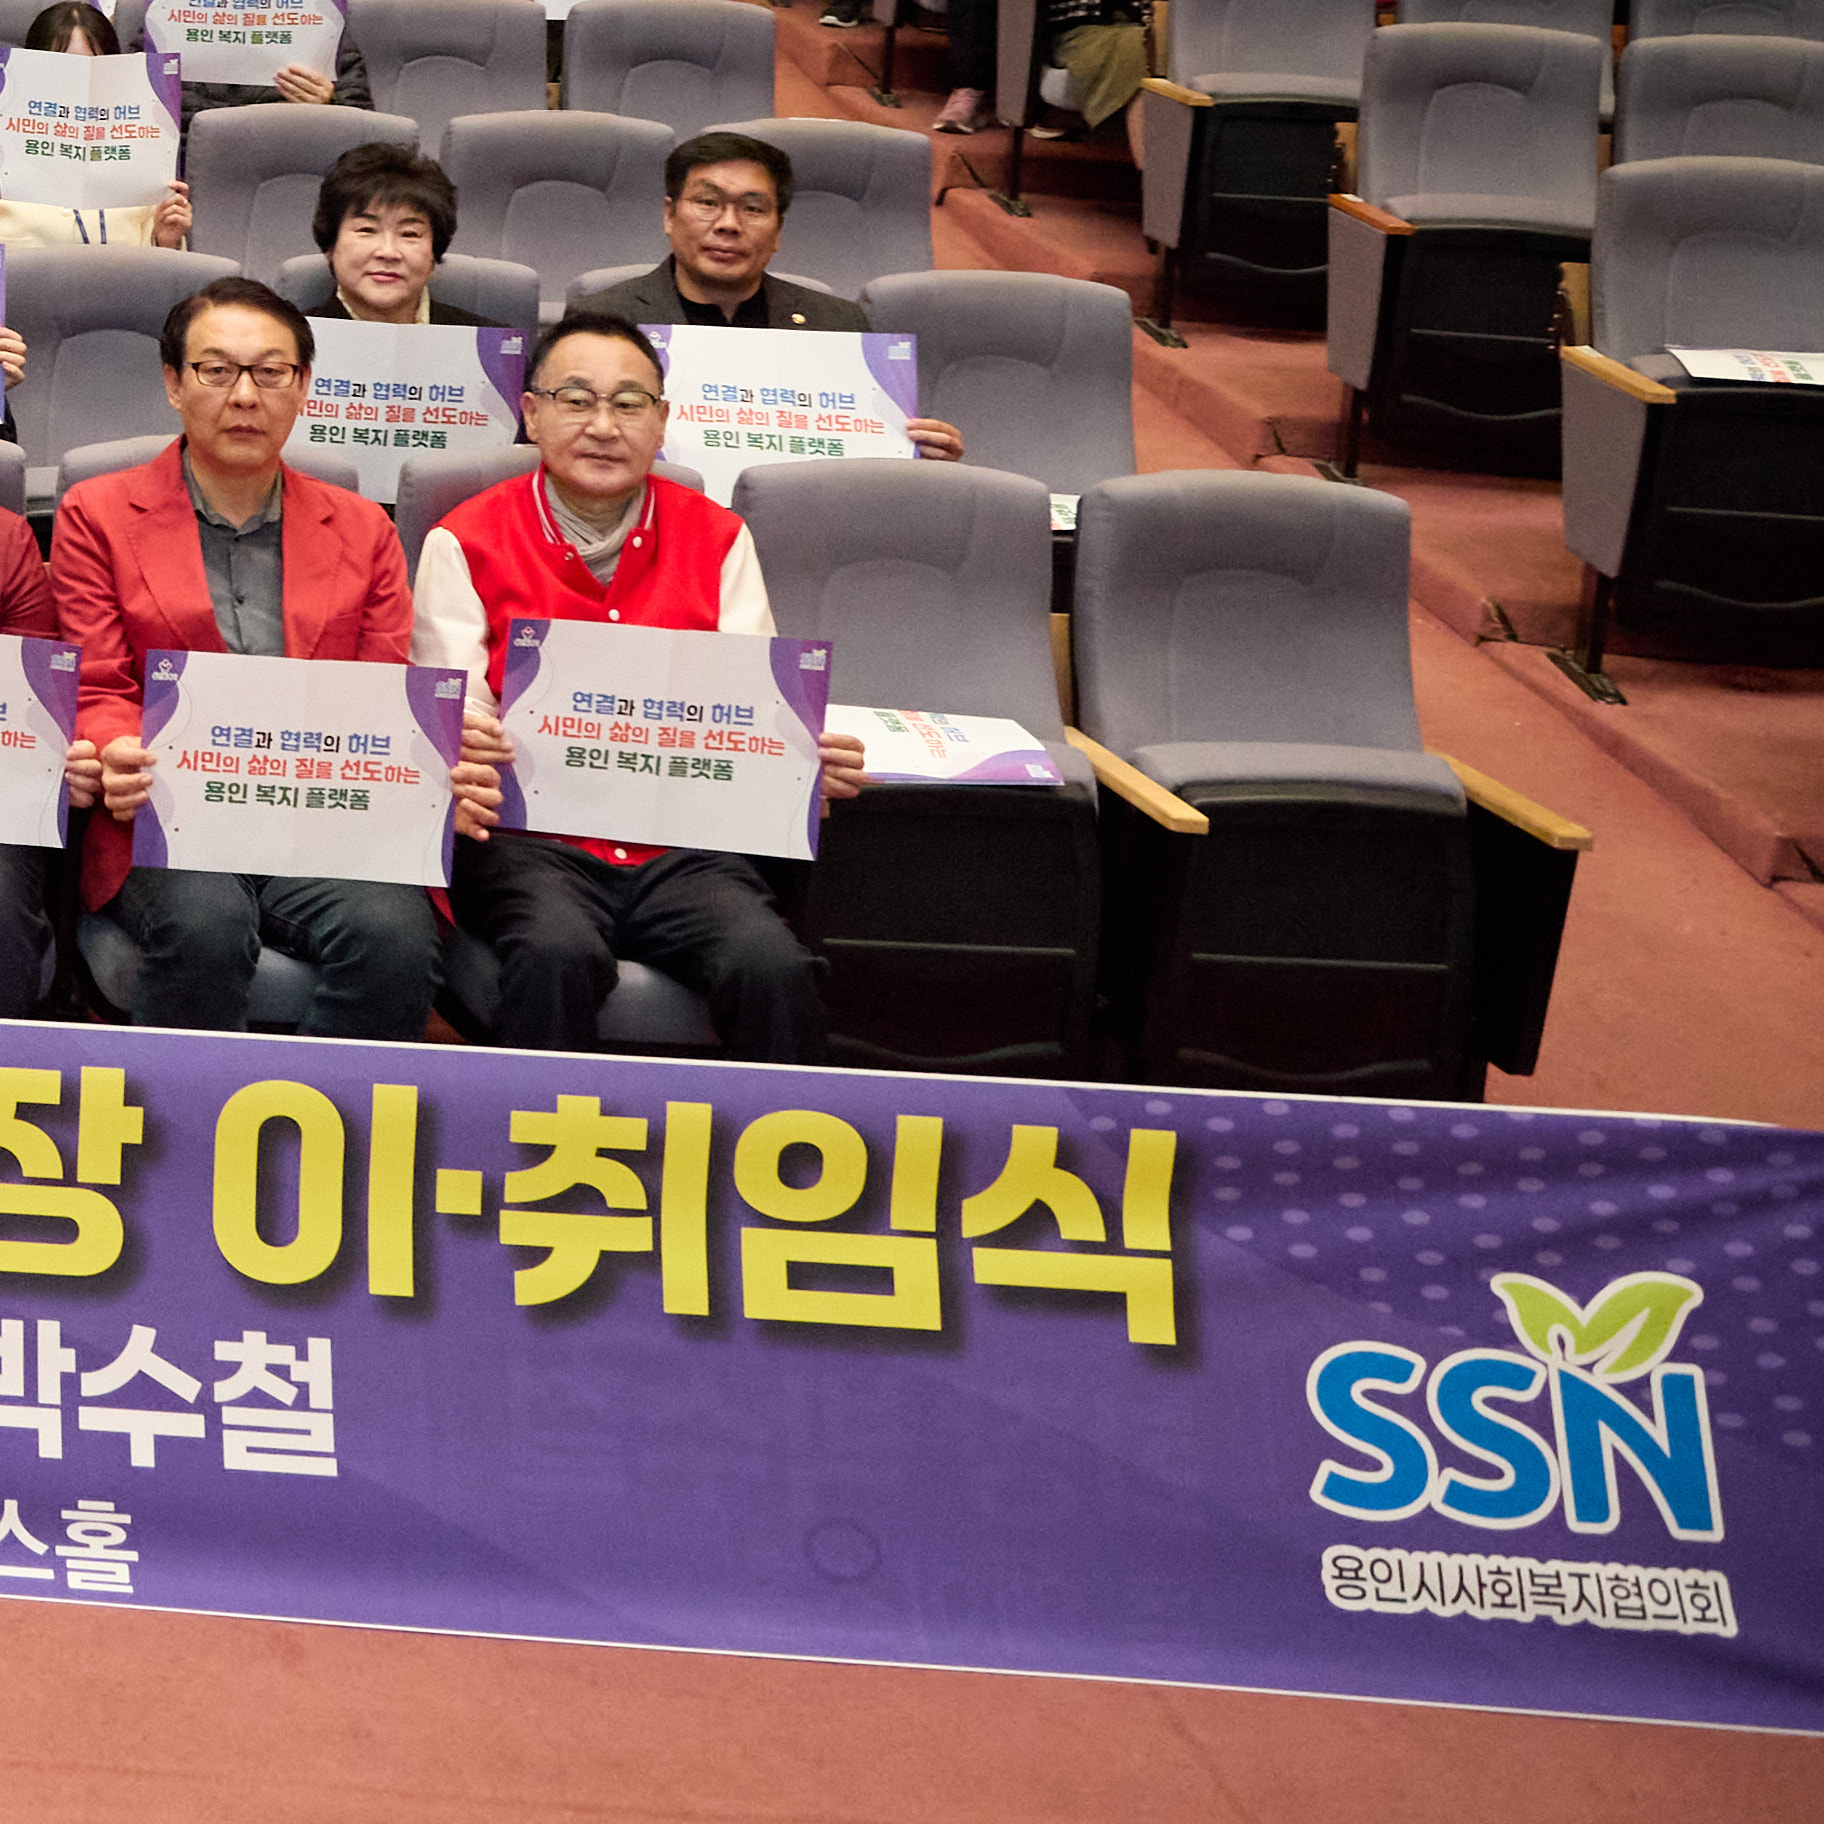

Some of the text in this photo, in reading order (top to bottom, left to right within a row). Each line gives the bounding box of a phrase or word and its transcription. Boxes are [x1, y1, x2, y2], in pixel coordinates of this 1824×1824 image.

[168, 10, 323, 27] 시민의 삶의 질을 선도하는
[186, 29, 292, 44] 용인 복지 플랫폼
[571, 691, 755, 727] 연결과 협력의 허브
[538, 714, 785, 757] 시민의 삶의 질을 선도하는
[565, 746, 734, 781] 용인 복지 플랫폼
[213, 1080, 1176, 1345] 이·취임식
[1314, 1348, 1716, 1533] SSN
[1330, 1554, 1728, 1627] 용인시사회복지협의회
